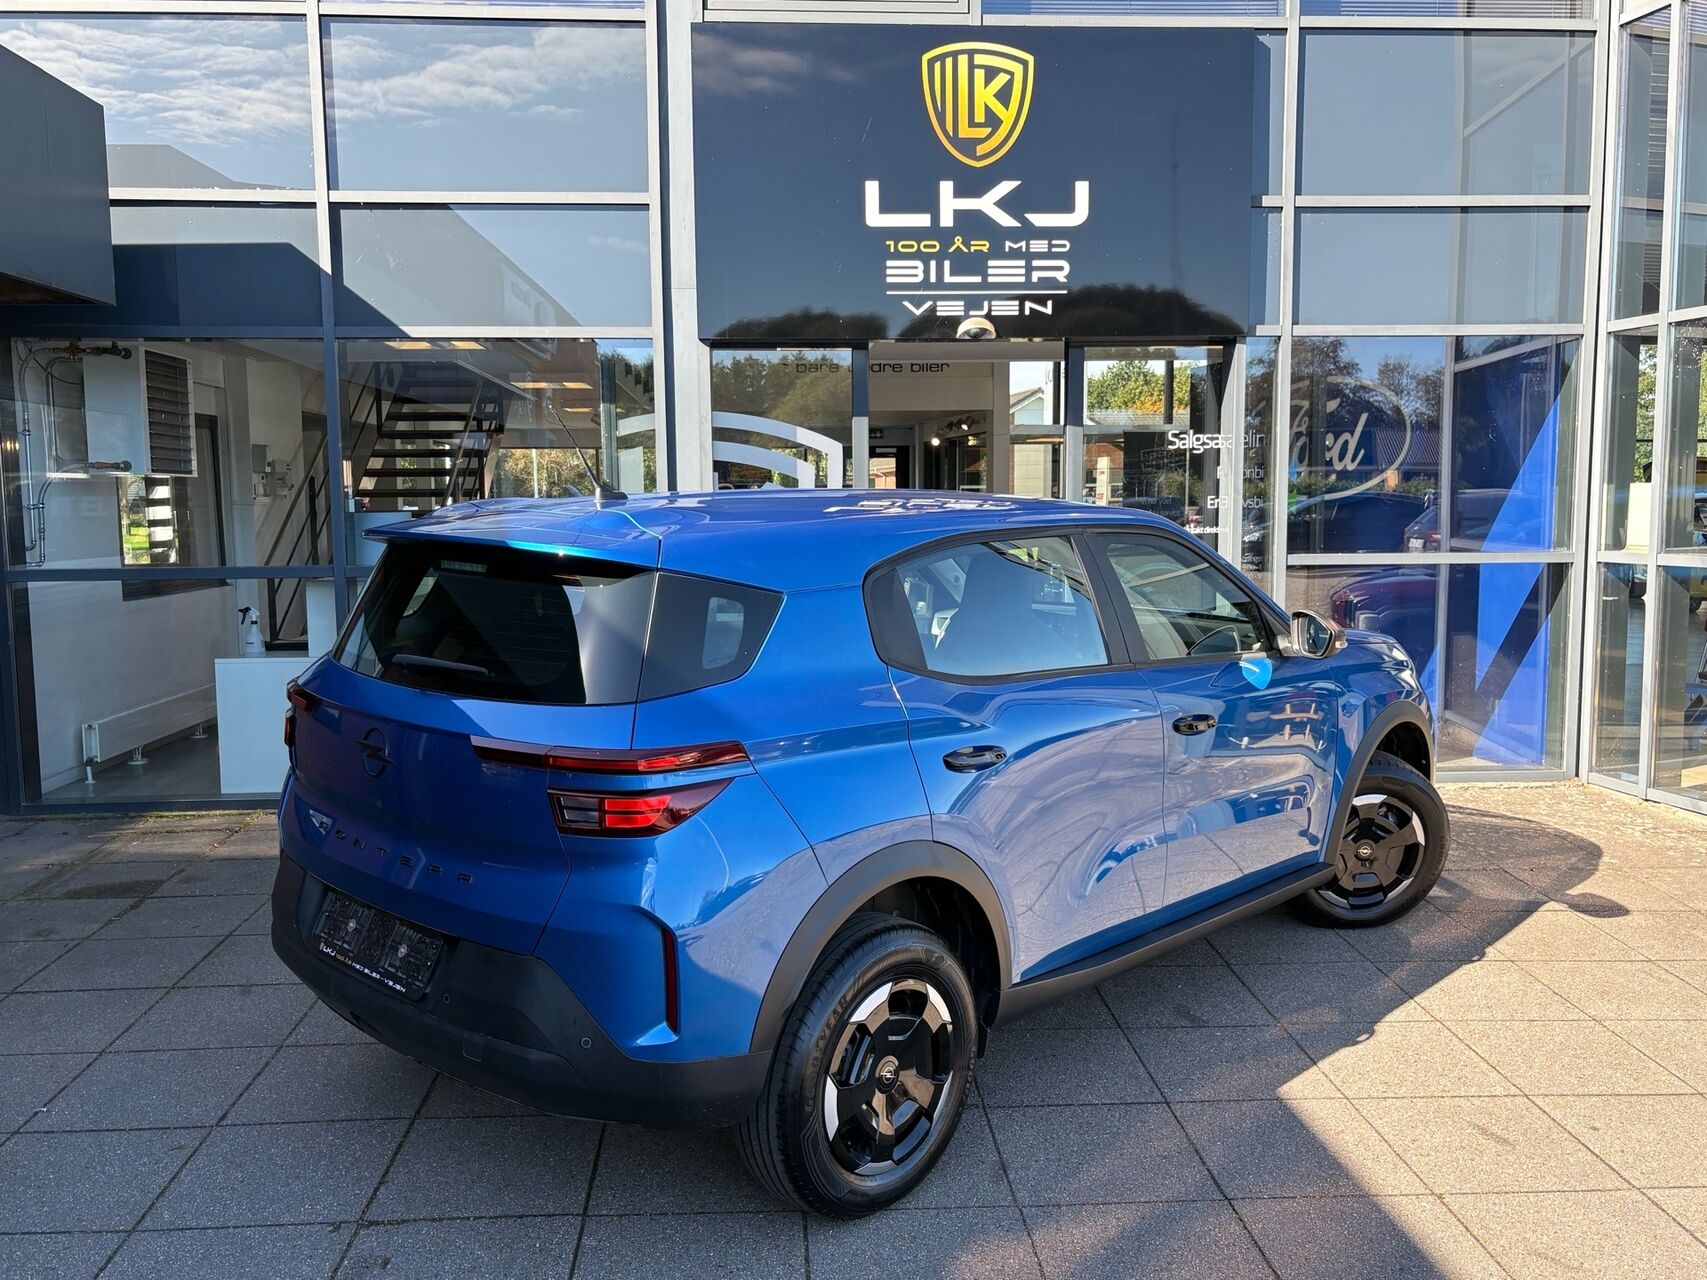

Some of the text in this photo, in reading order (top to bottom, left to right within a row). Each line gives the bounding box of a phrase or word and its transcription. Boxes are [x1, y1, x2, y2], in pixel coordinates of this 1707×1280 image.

[865, 180, 1089, 227] LKJ
[886, 236, 1070, 252] 100 ÅR MED
[886, 260, 1070, 283] BILER
[902, 300, 1052, 316] VEJEN
